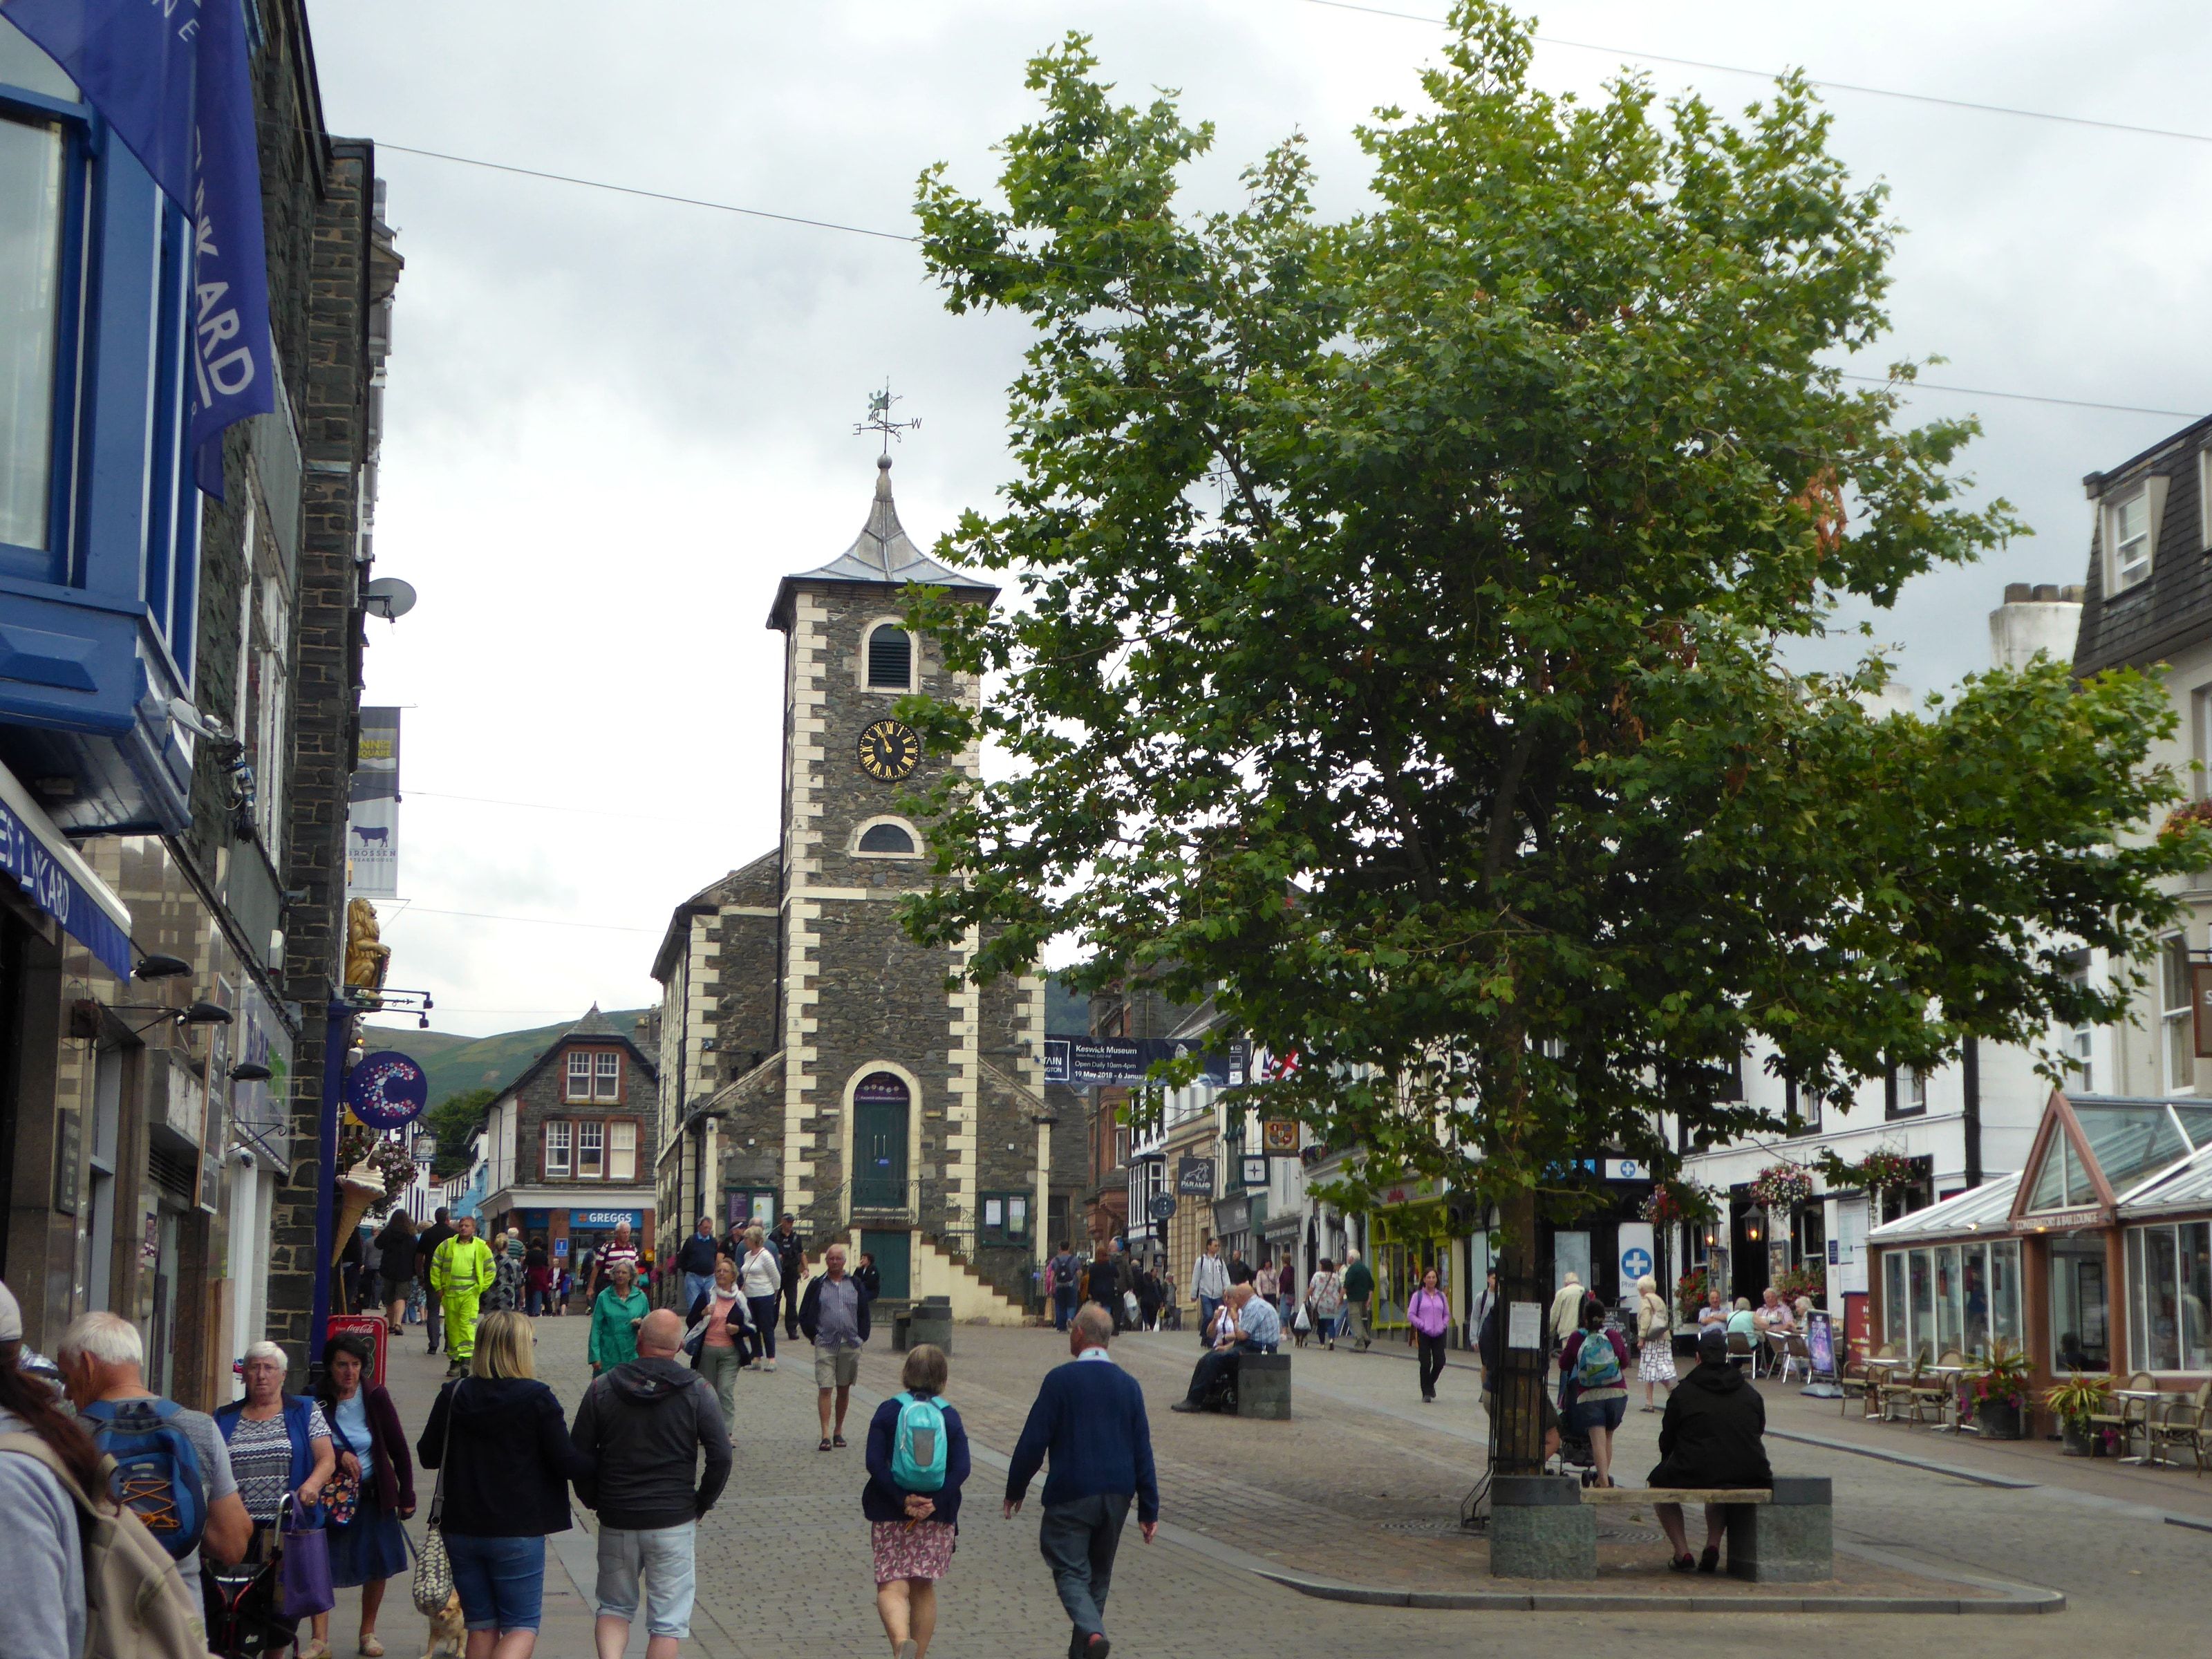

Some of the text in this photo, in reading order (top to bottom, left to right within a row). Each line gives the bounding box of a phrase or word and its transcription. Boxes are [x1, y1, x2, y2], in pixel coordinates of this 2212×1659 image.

[1076, 1044, 1137, 1054] Keswick Museum
[1091, 1061, 1106, 1069] Daily
[1083, 1071, 1096, 1079] May
[590, 1213, 631, 1223] GREGGS
